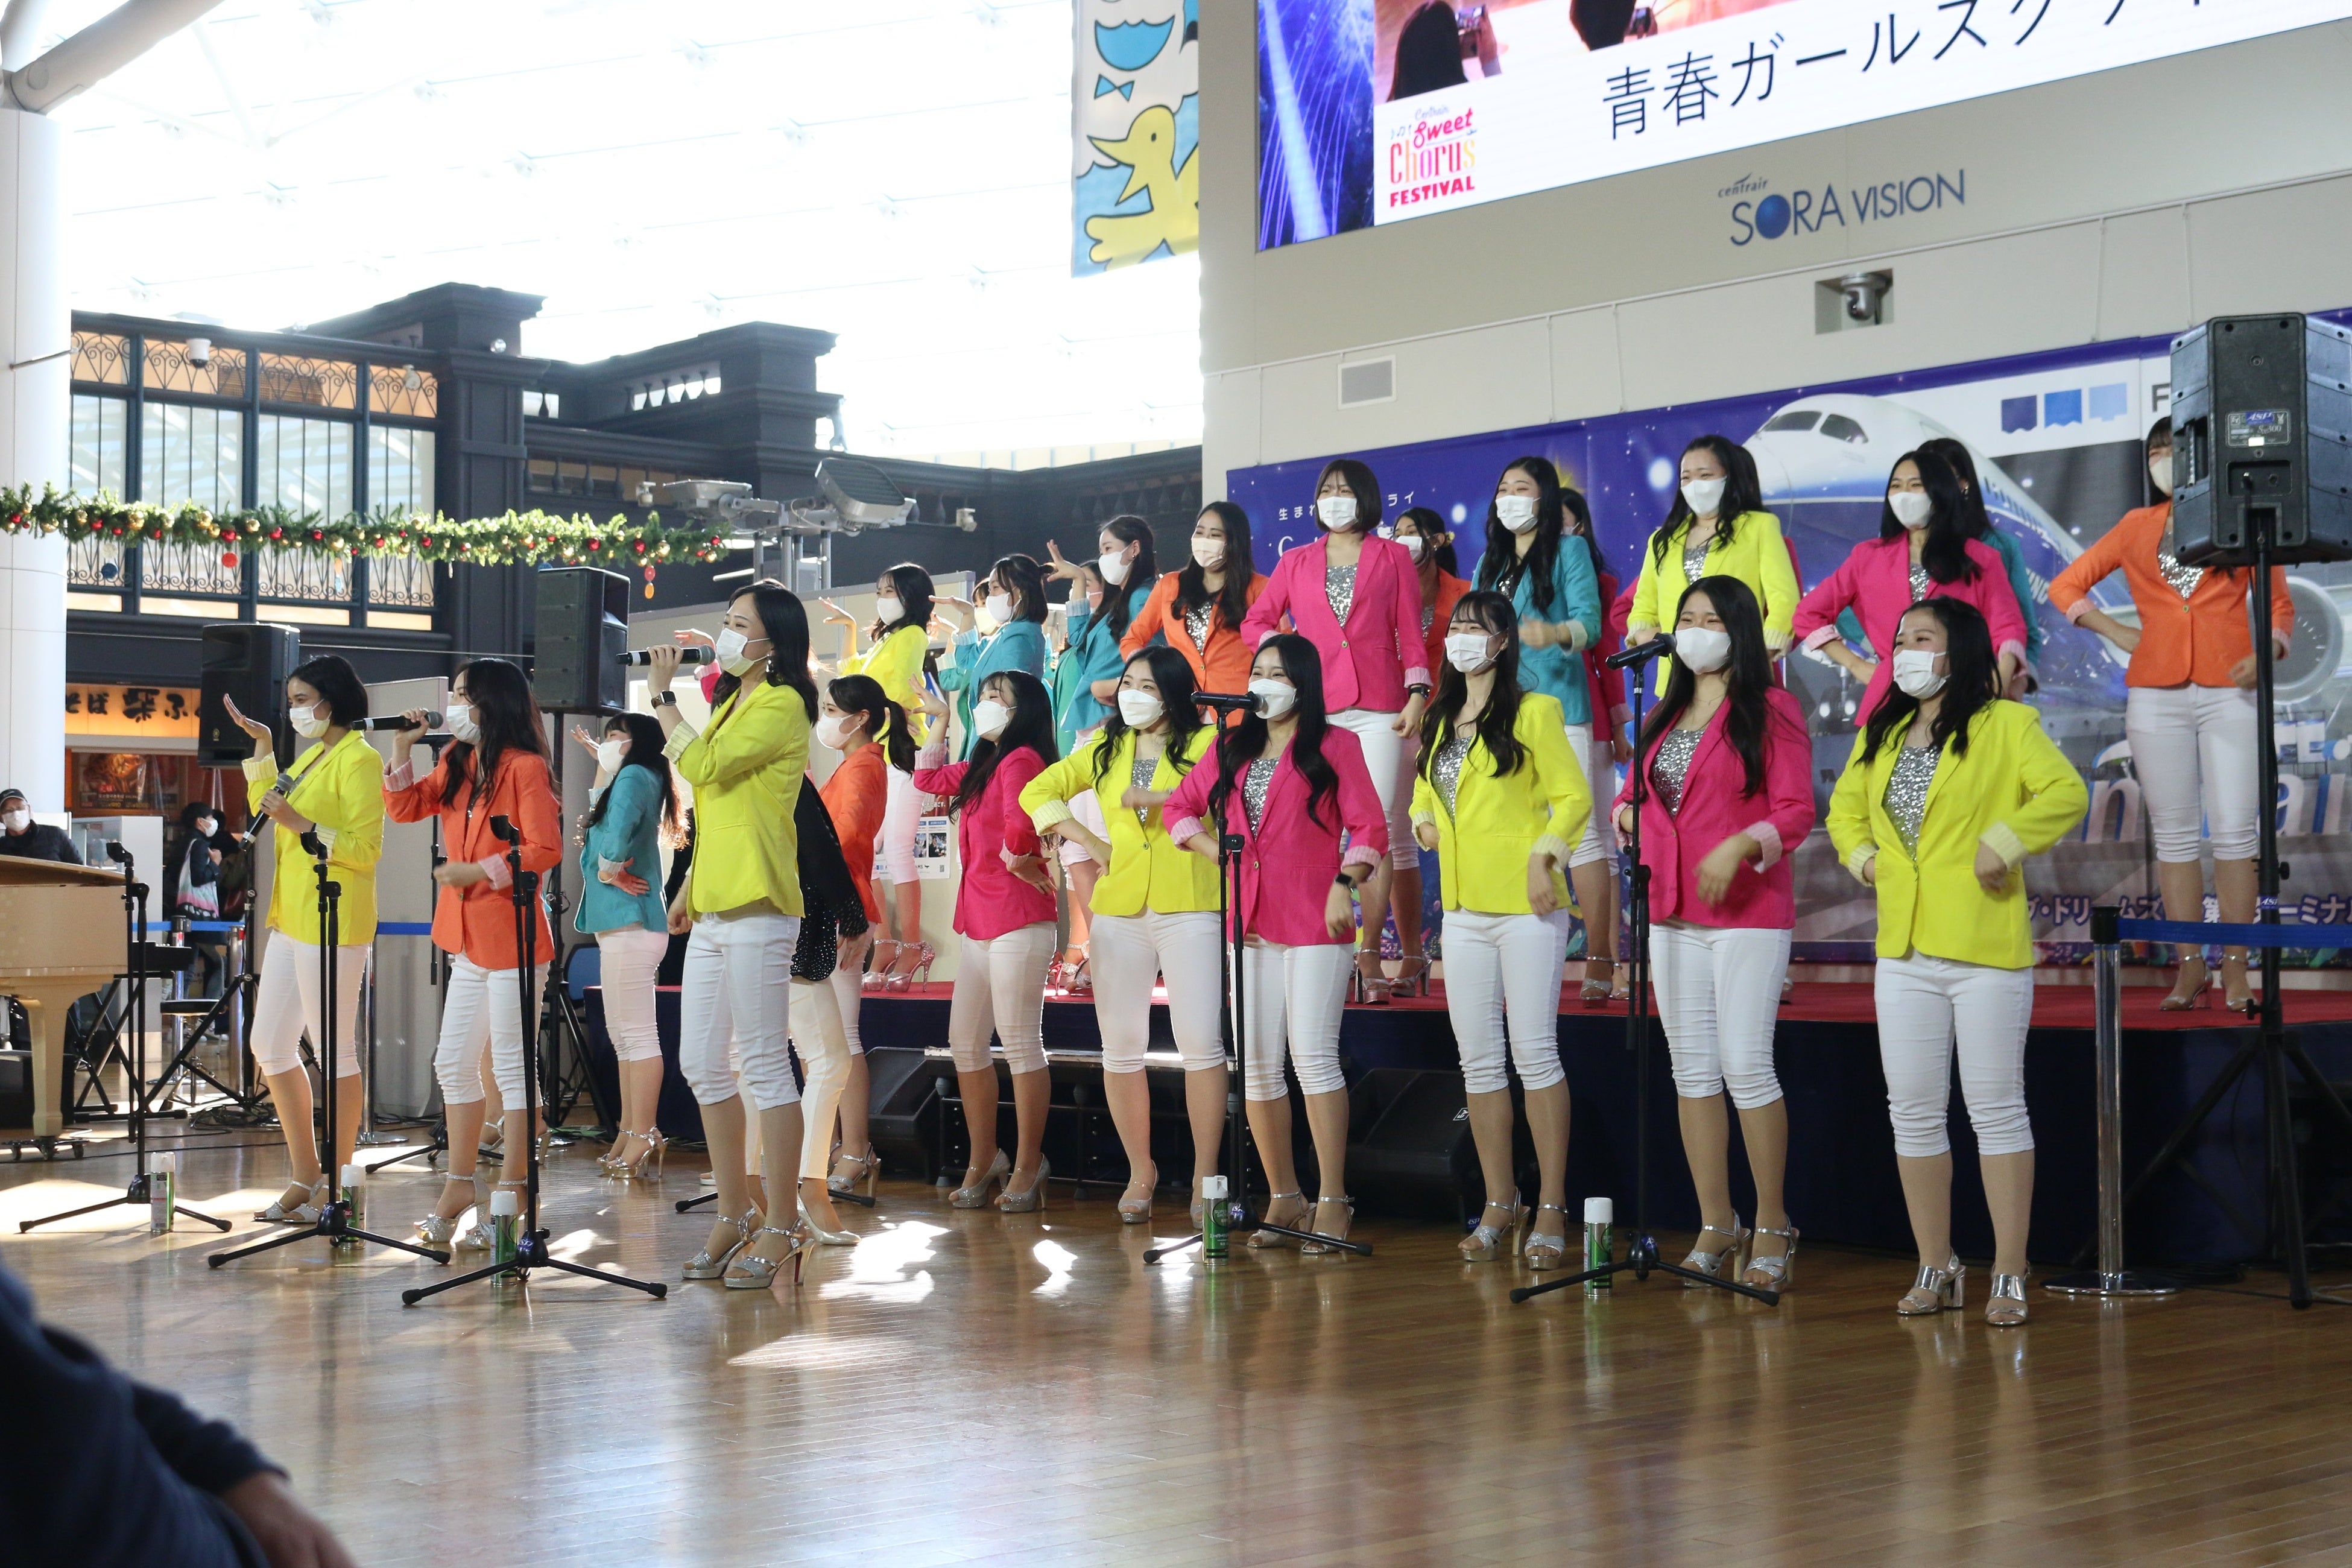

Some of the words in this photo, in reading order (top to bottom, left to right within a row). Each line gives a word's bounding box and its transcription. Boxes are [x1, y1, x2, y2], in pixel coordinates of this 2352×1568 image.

[1413, 107, 1473, 148] Sweet
[1390, 139, 1476, 185] Chorus
[1390, 175, 1475, 207] FESTIVAL
[1718, 172, 1769, 198] centrair
[1730, 183, 1845, 246] SORA
[1851, 168, 1965, 224] VISION
